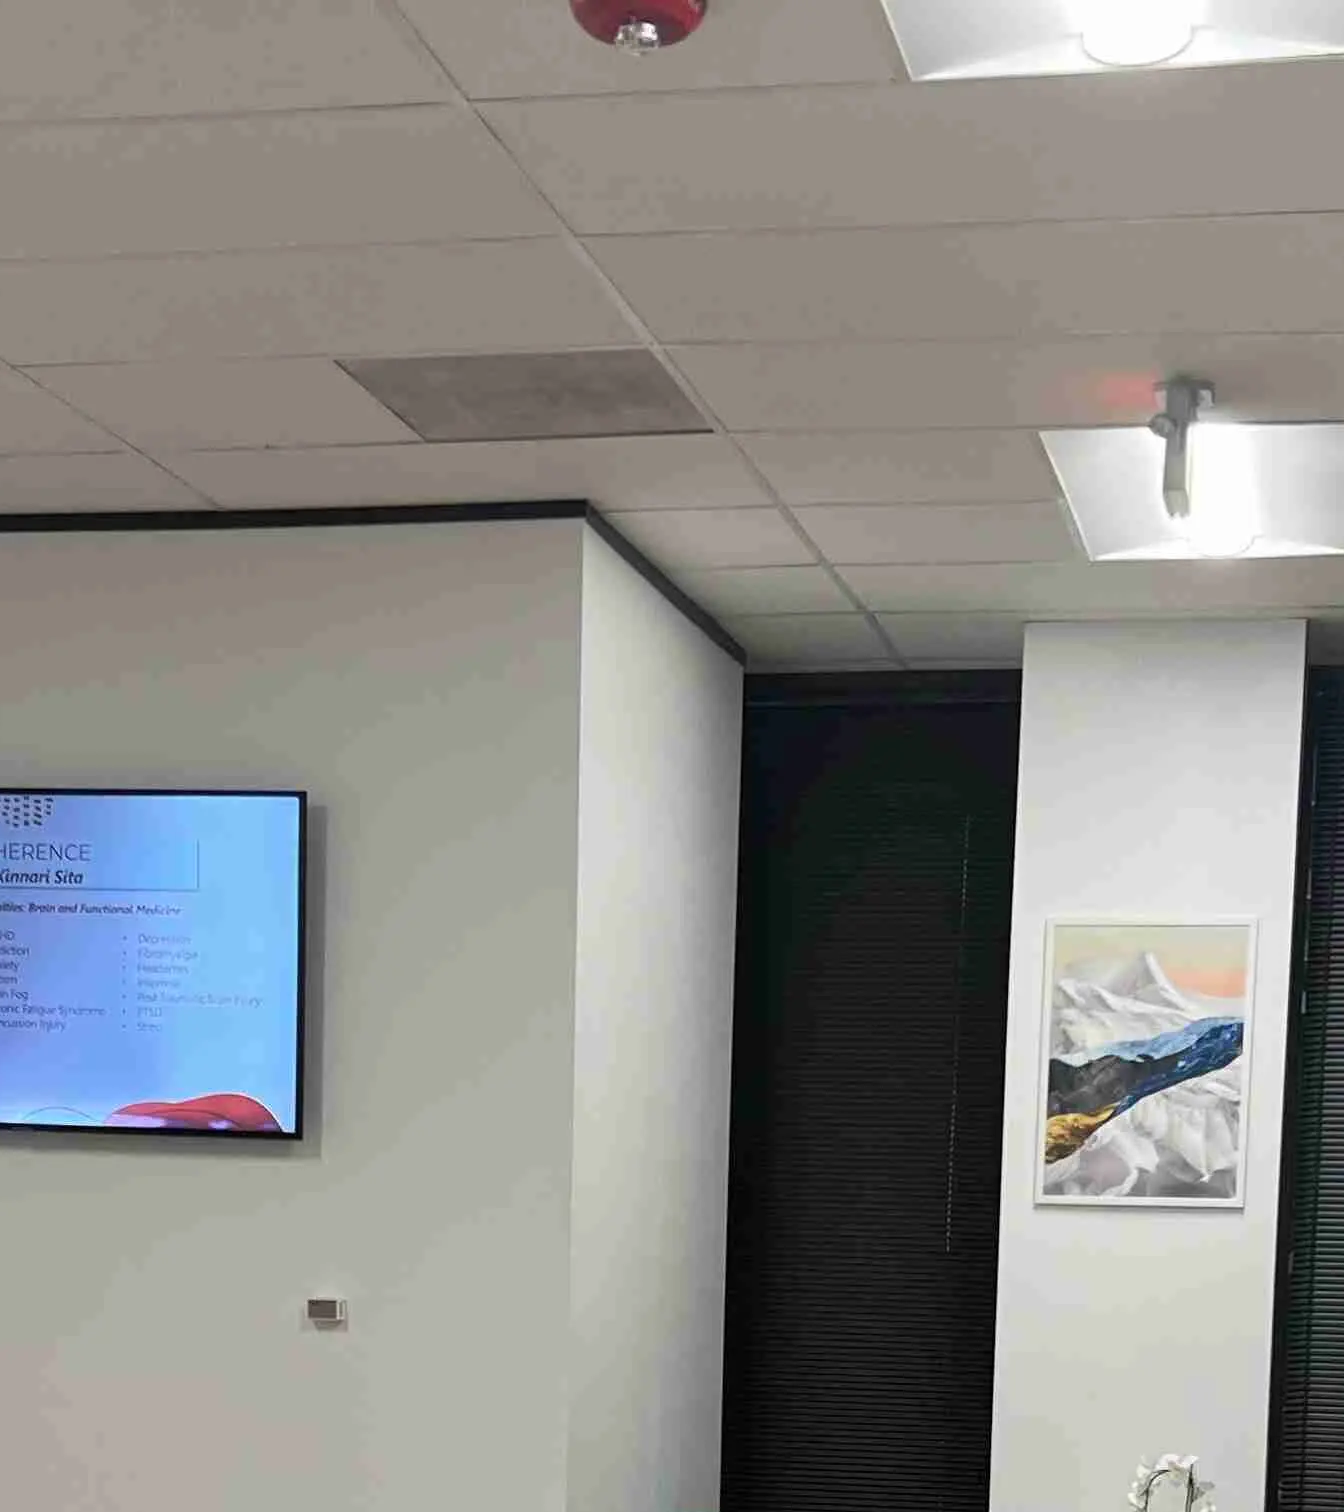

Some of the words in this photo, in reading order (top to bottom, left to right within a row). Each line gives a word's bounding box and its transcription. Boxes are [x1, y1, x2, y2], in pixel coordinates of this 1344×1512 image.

[54, 869, 84, 885] Sita
[57, 903, 78, 914] and
[79, 903, 134, 915] Functional
[136, 904, 182, 915] Medicine
